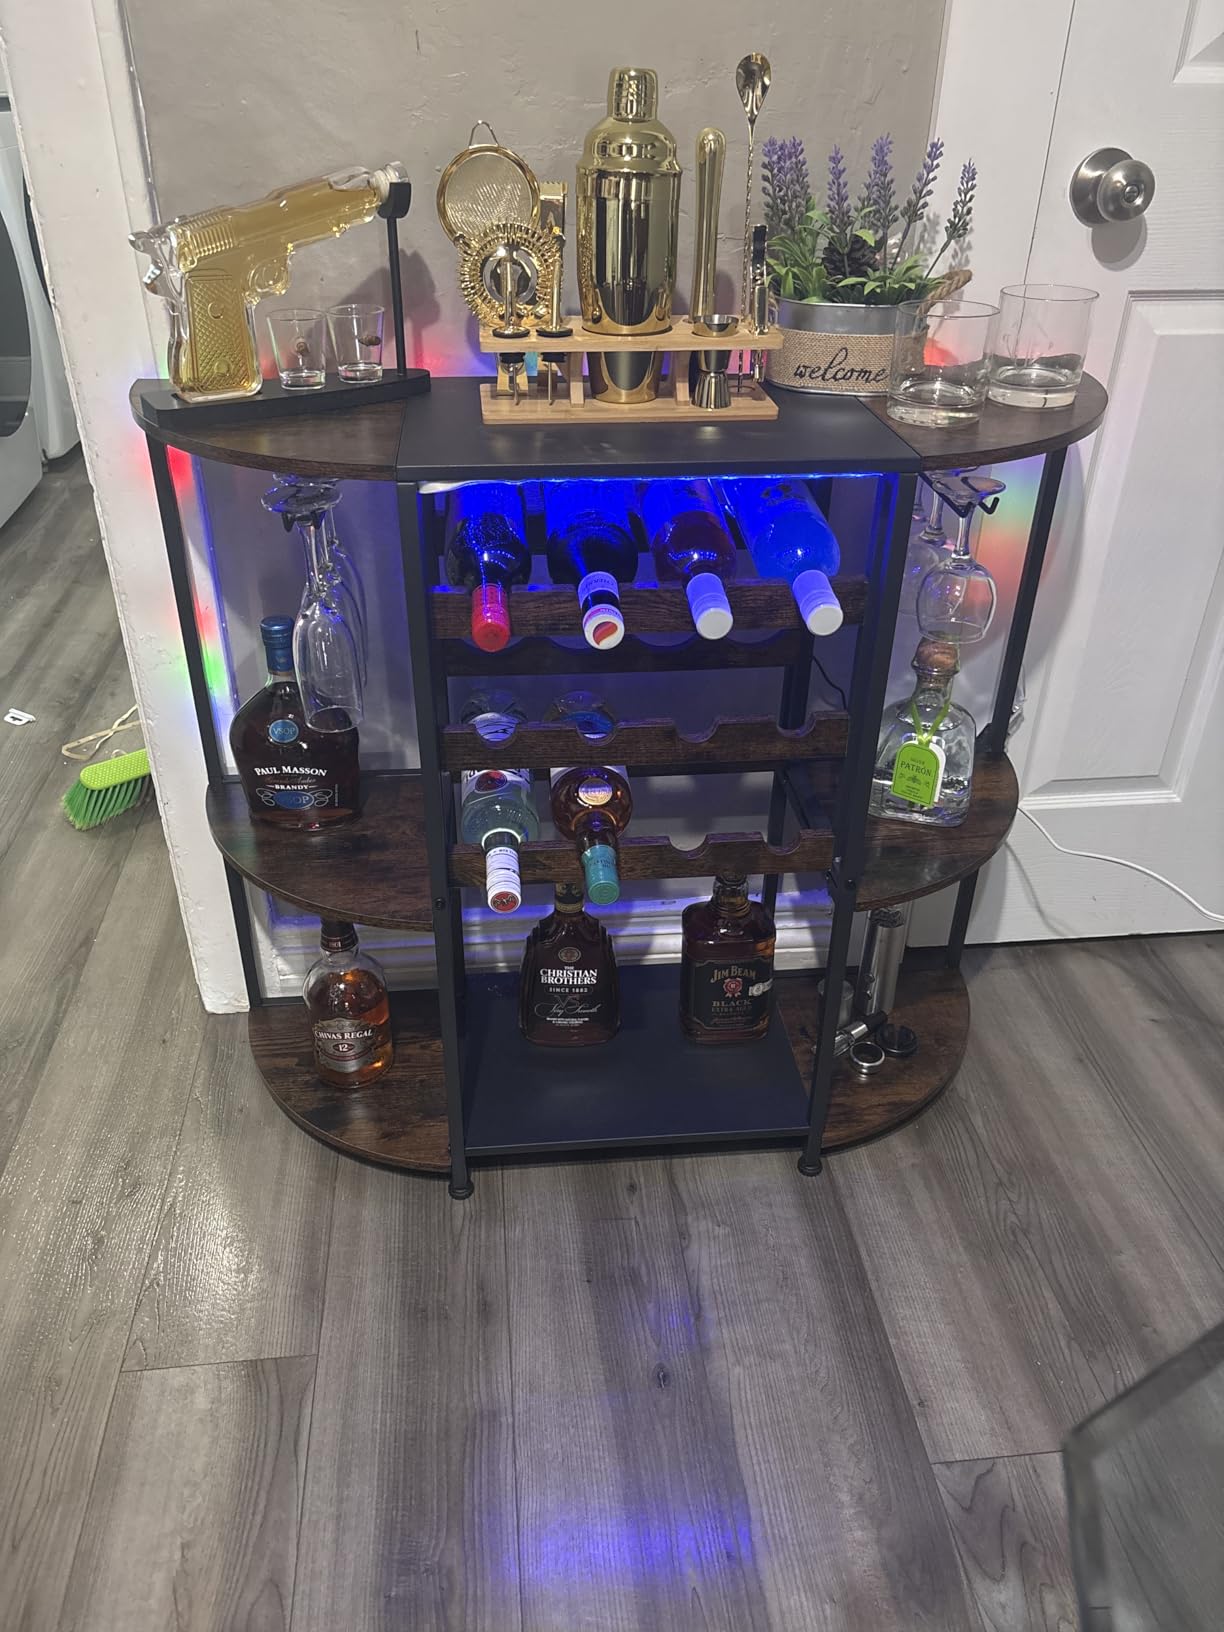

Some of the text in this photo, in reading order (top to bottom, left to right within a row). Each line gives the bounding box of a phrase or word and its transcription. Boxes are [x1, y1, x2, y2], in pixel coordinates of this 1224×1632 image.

[794, 346, 890, 383] welcome
[272, 728, 296, 736] VSOP
[254, 765, 328, 777] PAUL MASSON
[540, 968, 598, 978] CHRISTIAN
[710, 965, 757, 983] JIM BEAM
[540, 976, 597, 985] BROTHERS
[711, 999, 753, 1007] BLACK
[315, 1029, 373, 1040] CHIVAS REGAL
[338, 1043, 348, 1052] 12
